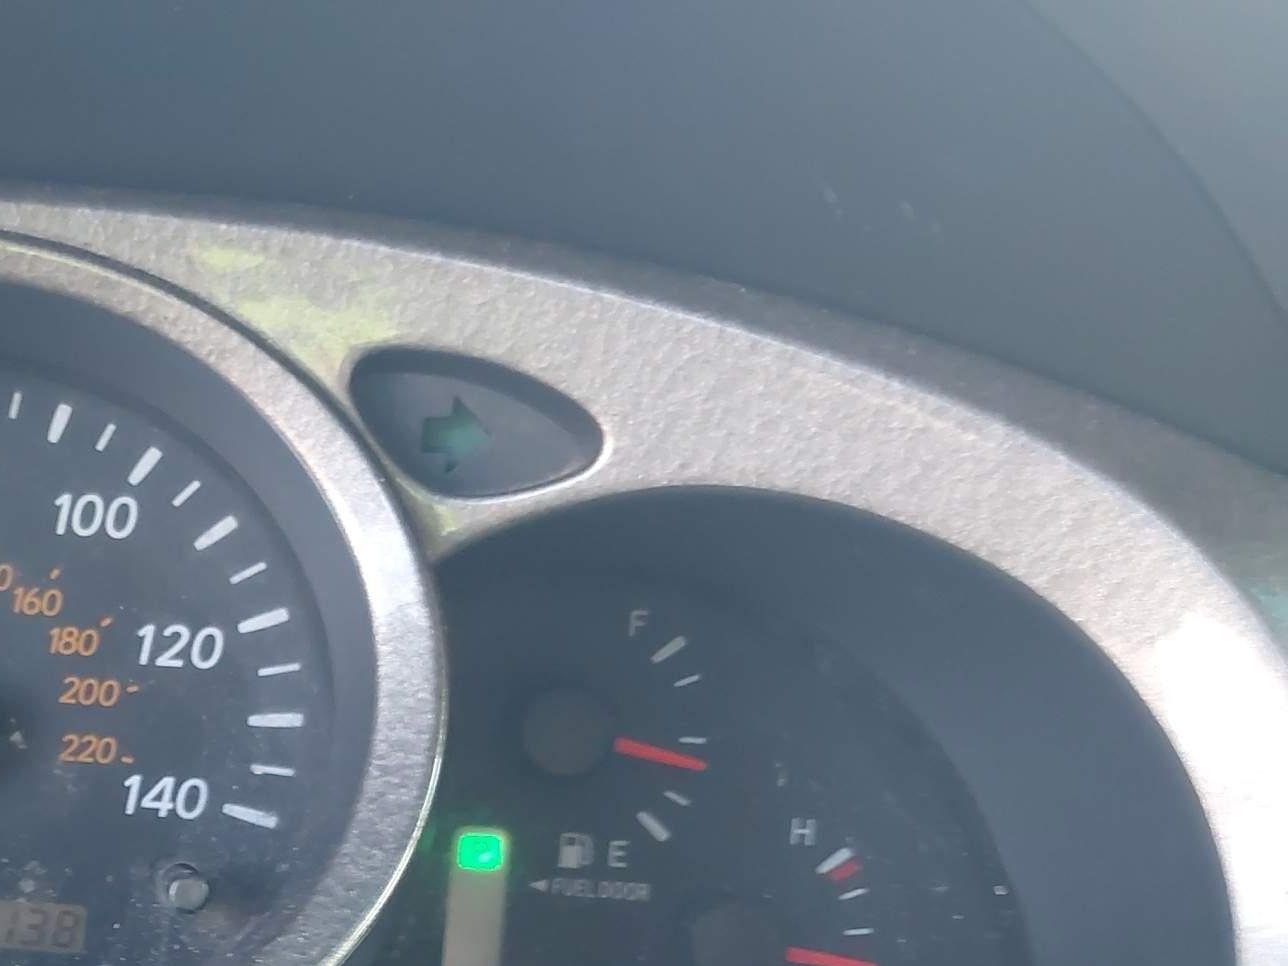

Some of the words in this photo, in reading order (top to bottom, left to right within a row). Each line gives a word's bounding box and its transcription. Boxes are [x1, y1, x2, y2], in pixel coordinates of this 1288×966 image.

[54, 493, 139, 539] 100
[13, 586, 63, 617] 160
[628, 610, 651, 637] F
[48, 627, 99, 657] 180
[136, 624, 224, 670] 120
[58, 677, 121, 707] 200
[58, 734, 117, 764] 220
[123, 774, 209, 820] 140
[789, 818, 817, 846] H
[608, 840, 631, 867] E
